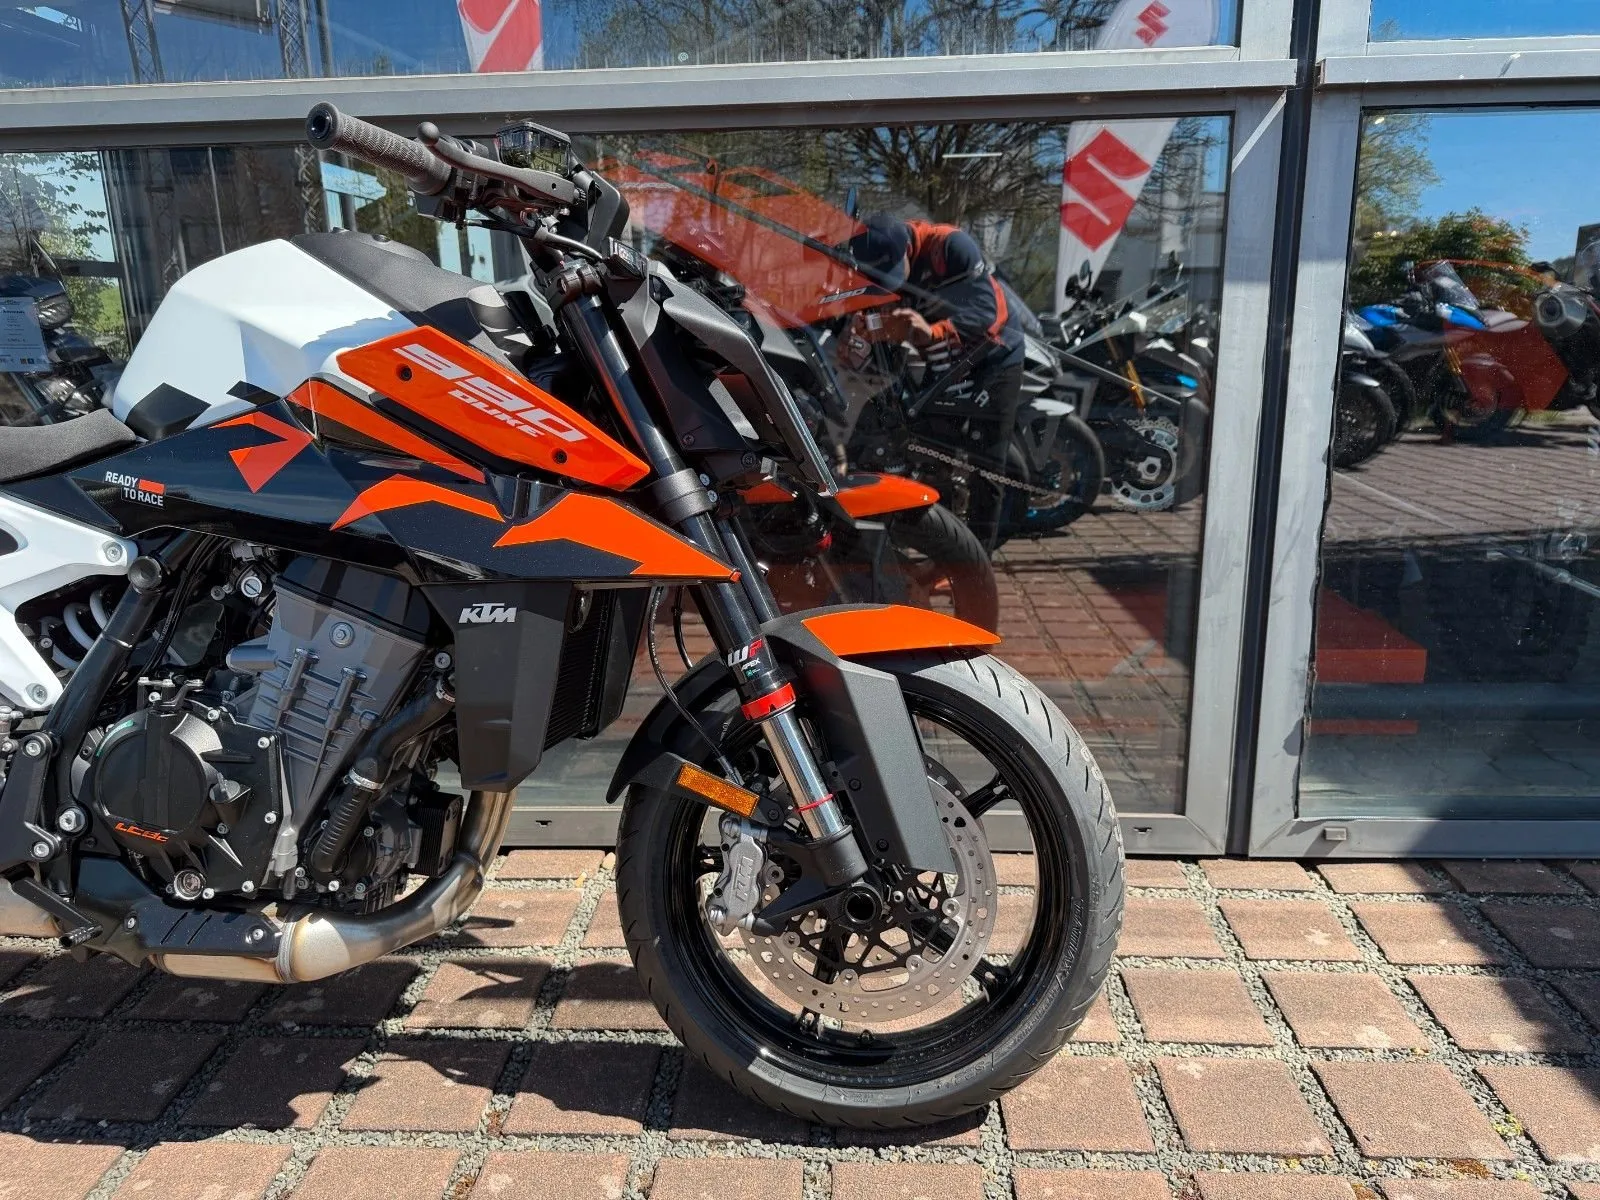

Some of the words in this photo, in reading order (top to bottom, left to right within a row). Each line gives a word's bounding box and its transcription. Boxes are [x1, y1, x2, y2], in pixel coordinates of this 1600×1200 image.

[392, 343, 589, 442] 990
[448, 389, 545, 437] DUKE
[105, 471, 138, 488] READY
[123, 487, 136, 500] TO
[137, 490, 164, 507] RACE
[458, 602, 517, 624] KTM
[732, 855, 755, 903] KTM
